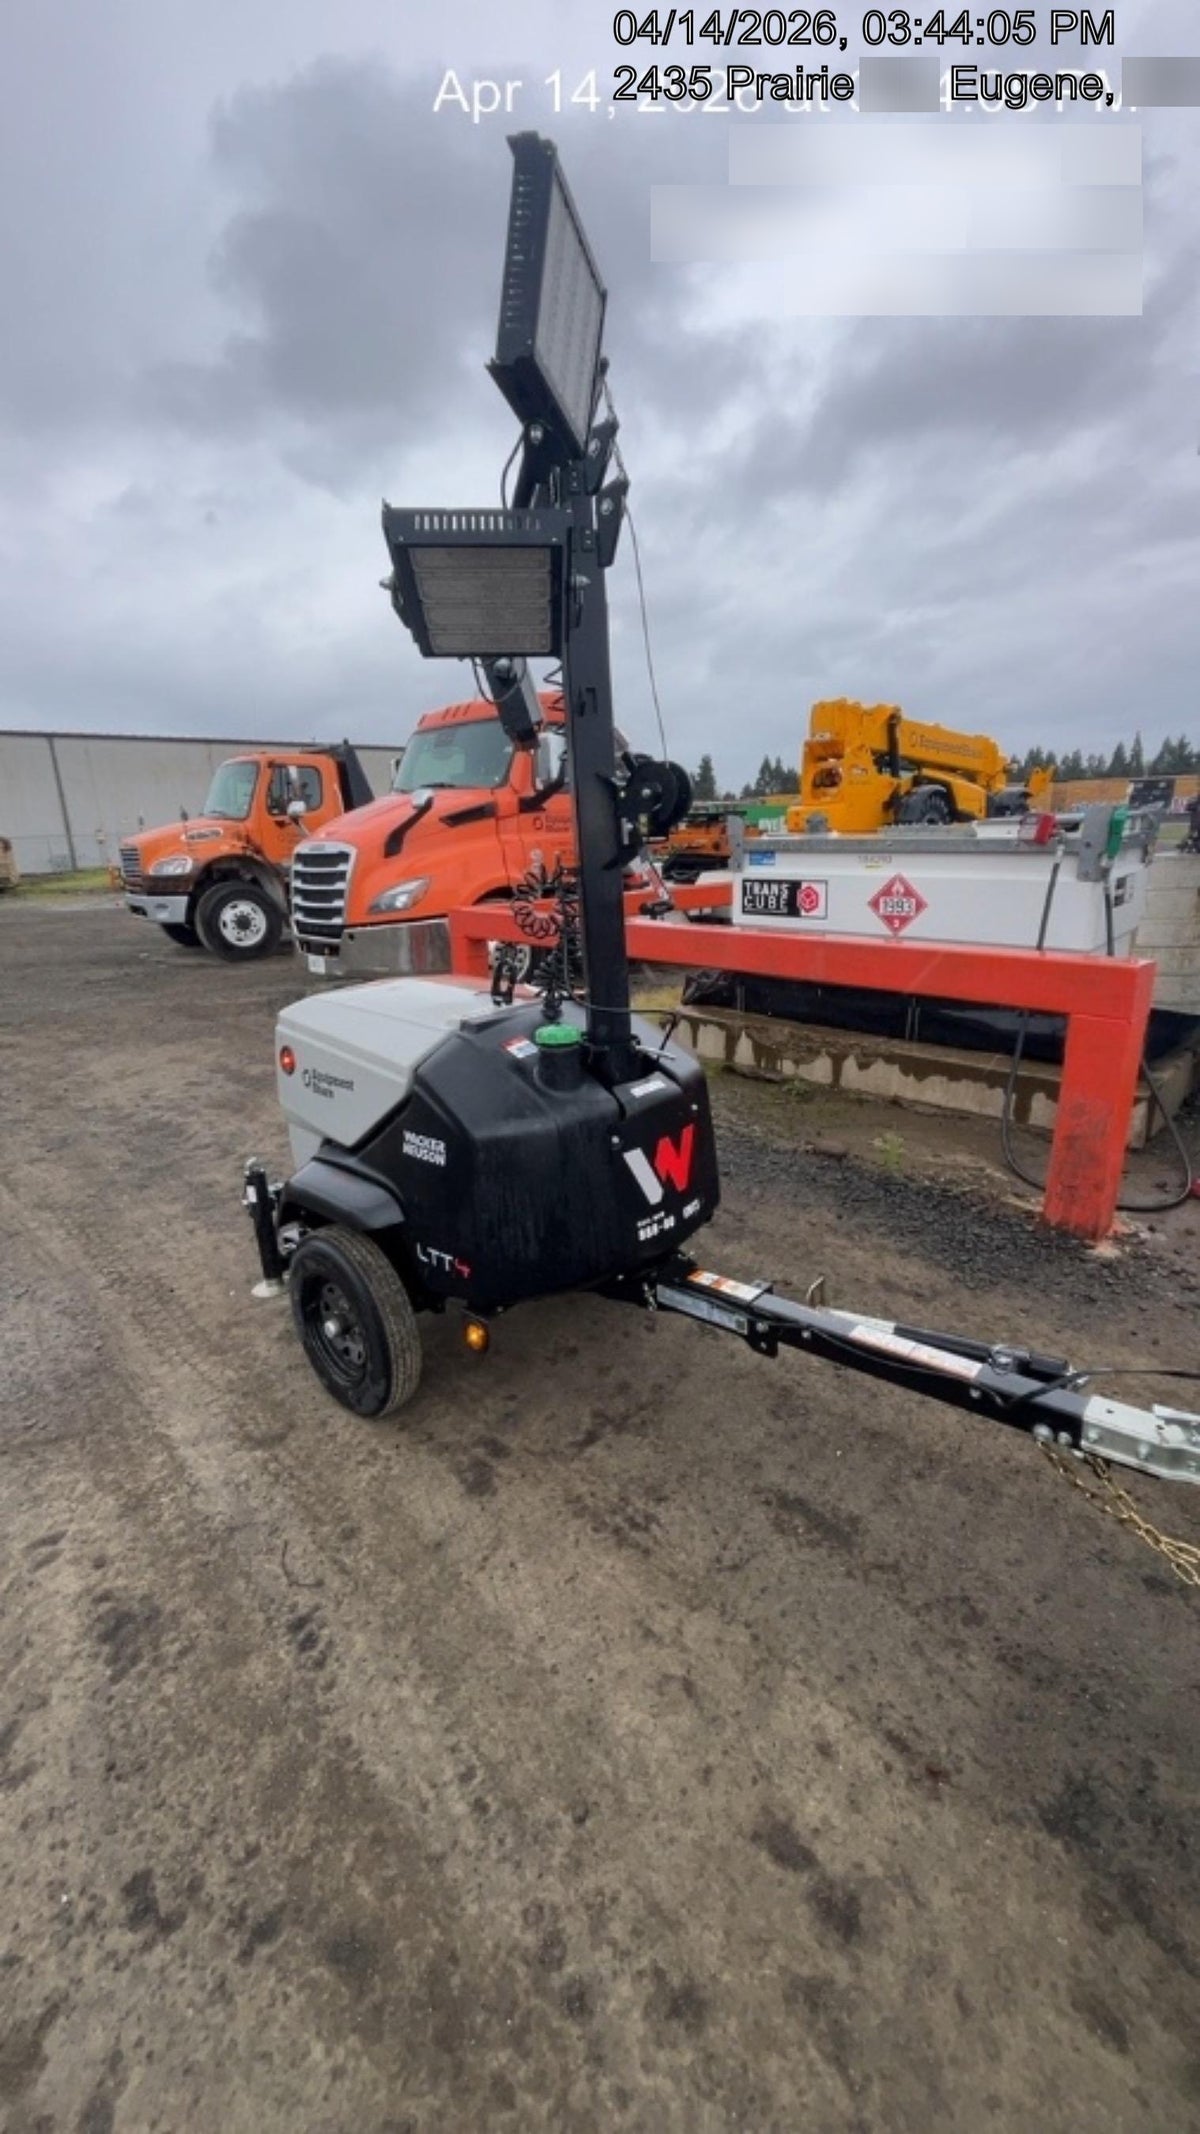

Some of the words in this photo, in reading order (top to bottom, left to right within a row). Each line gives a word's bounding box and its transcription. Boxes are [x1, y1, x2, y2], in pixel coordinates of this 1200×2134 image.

[744, 881, 790, 898] TRANS
[744, 895, 788, 910] CUBE
[882, 897, 914, 914] 1993
[402, 1130, 446, 1153] WACKER
[402, 1142, 447, 1167] NEUSON
